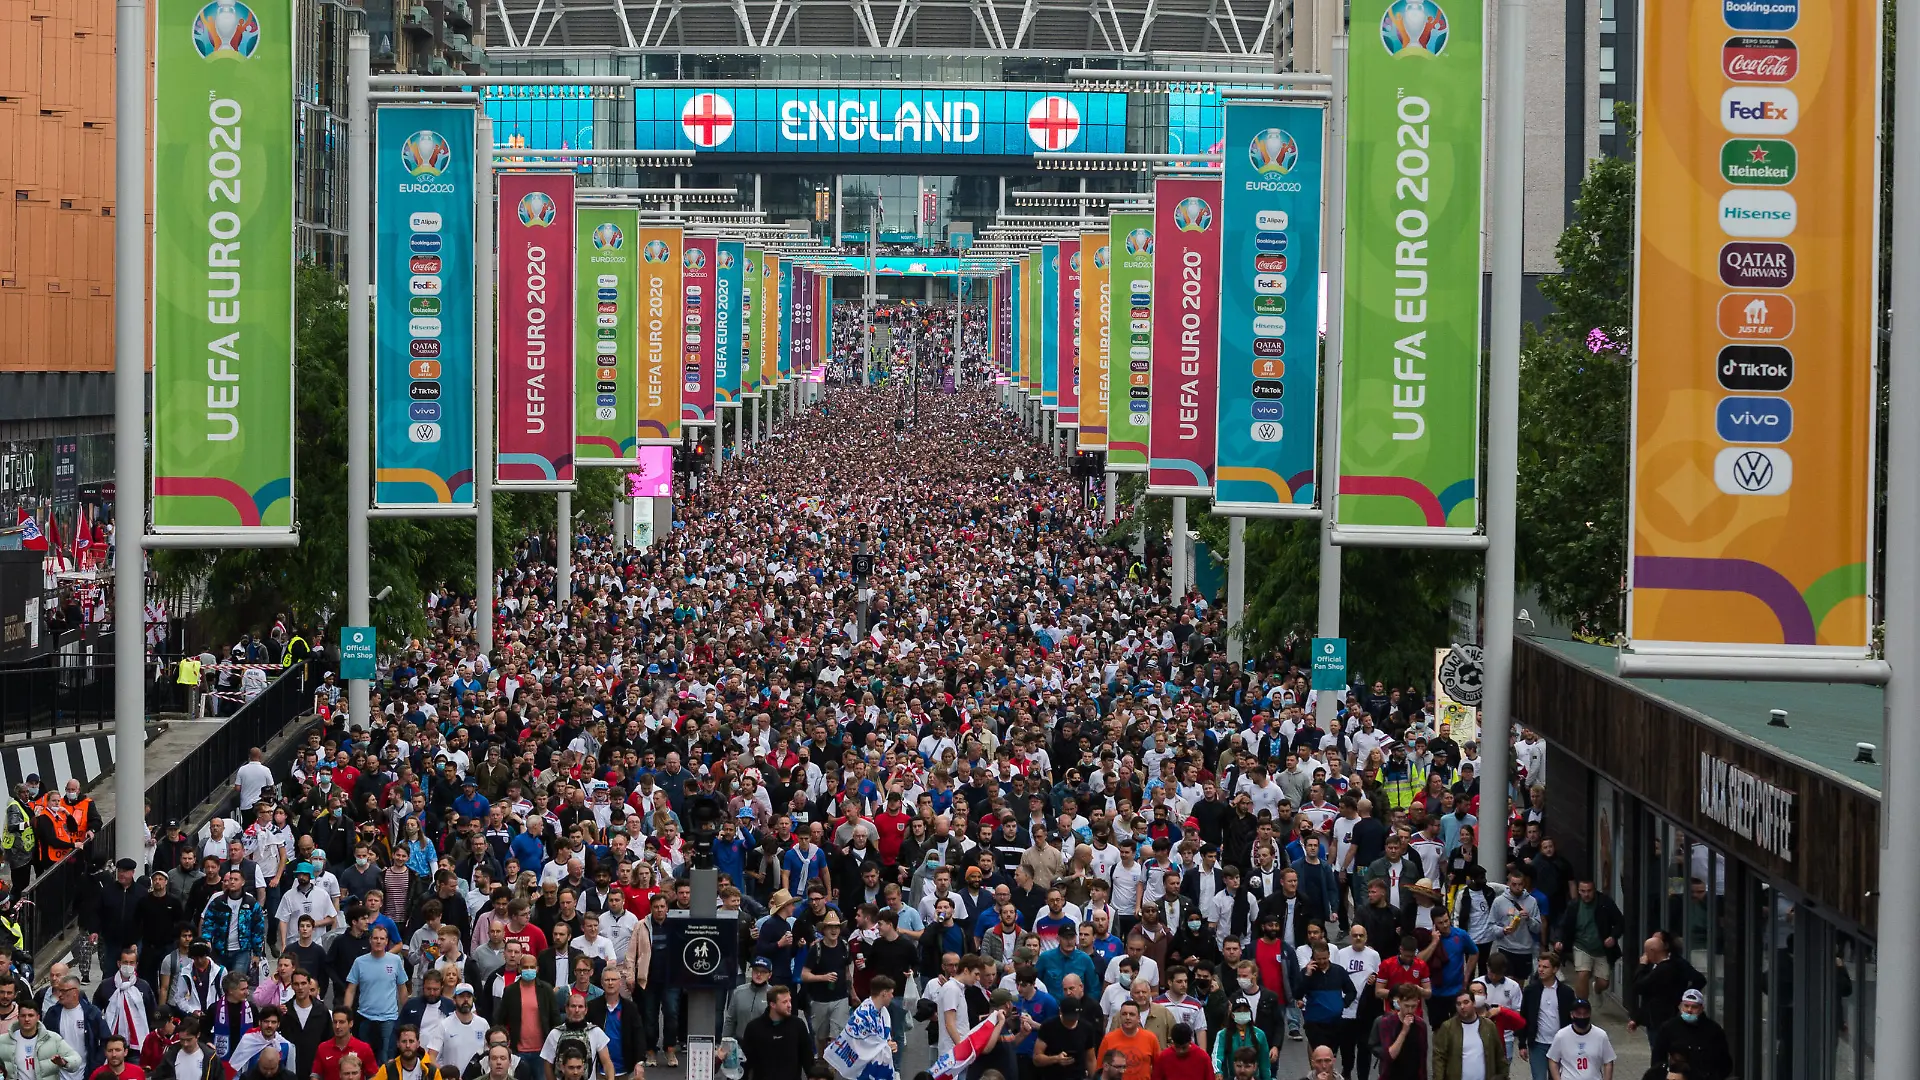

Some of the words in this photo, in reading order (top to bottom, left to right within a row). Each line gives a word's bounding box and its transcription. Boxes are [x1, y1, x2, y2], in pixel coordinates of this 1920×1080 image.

[1726, 1, 1796, 14] Booking.com
[782, 100, 980, 142] ENGLAND
[1730, 101, 1788, 120] FedEx
[208, 98, 242, 203] 2020
[1396, 96, 1430, 202] 2020
[416, 174, 435, 183] UEFA
[1264, 171, 1282, 180] UEFA
[1728, 165, 1788, 178] Heineken
[399, 183, 454, 193] EURO2020
[1246, 181, 1301, 192] EURO2020
[420, 218, 438, 226] Alipay
[1725, 207, 1791, 220] Hisense
[208, 212, 241, 323] EURO
[1394, 209, 1428, 323] EURO
[1727, 252, 1786, 268] QATAR
[527, 246, 546, 304] 2020
[1182, 251, 1202, 309] 2020
[1258, 280, 1282, 288] FedEx
[1740, 268, 1787, 278] AIRWAYS
[413, 282, 437, 290] FedEx
[650, 277, 663, 317] 2020
[718, 279, 729, 310] 2020
[527, 308, 546, 370] EURO
[717, 311, 728, 344] EURO
[650, 320, 663, 362] EURO
[1181, 314, 1200, 376] EURO
[716, 346, 727, 378] UEFA
[1739, 363, 1787, 377] TikTok
[208, 332, 240, 440] UEFA
[649, 366, 662, 407] UEFA
[1392, 331, 1426, 440] UEFA
[527, 374, 545, 434] UEFA
[1180, 379, 1199, 440] UEFA
[1730, 411, 1779, 426] vivo
[1701, 752, 1727, 827] BLACK
[1729, 766, 1755, 840] SHEEP
[1756, 780, 1792, 862] COFFEE
[1101, 864, 1105, 873] 9
[1480, 901, 1485, 911] 6
[1350, 960, 1363, 971] ENG
[25, 1058, 35, 1070] 14
[1577, 1058, 1588, 1070] 20
